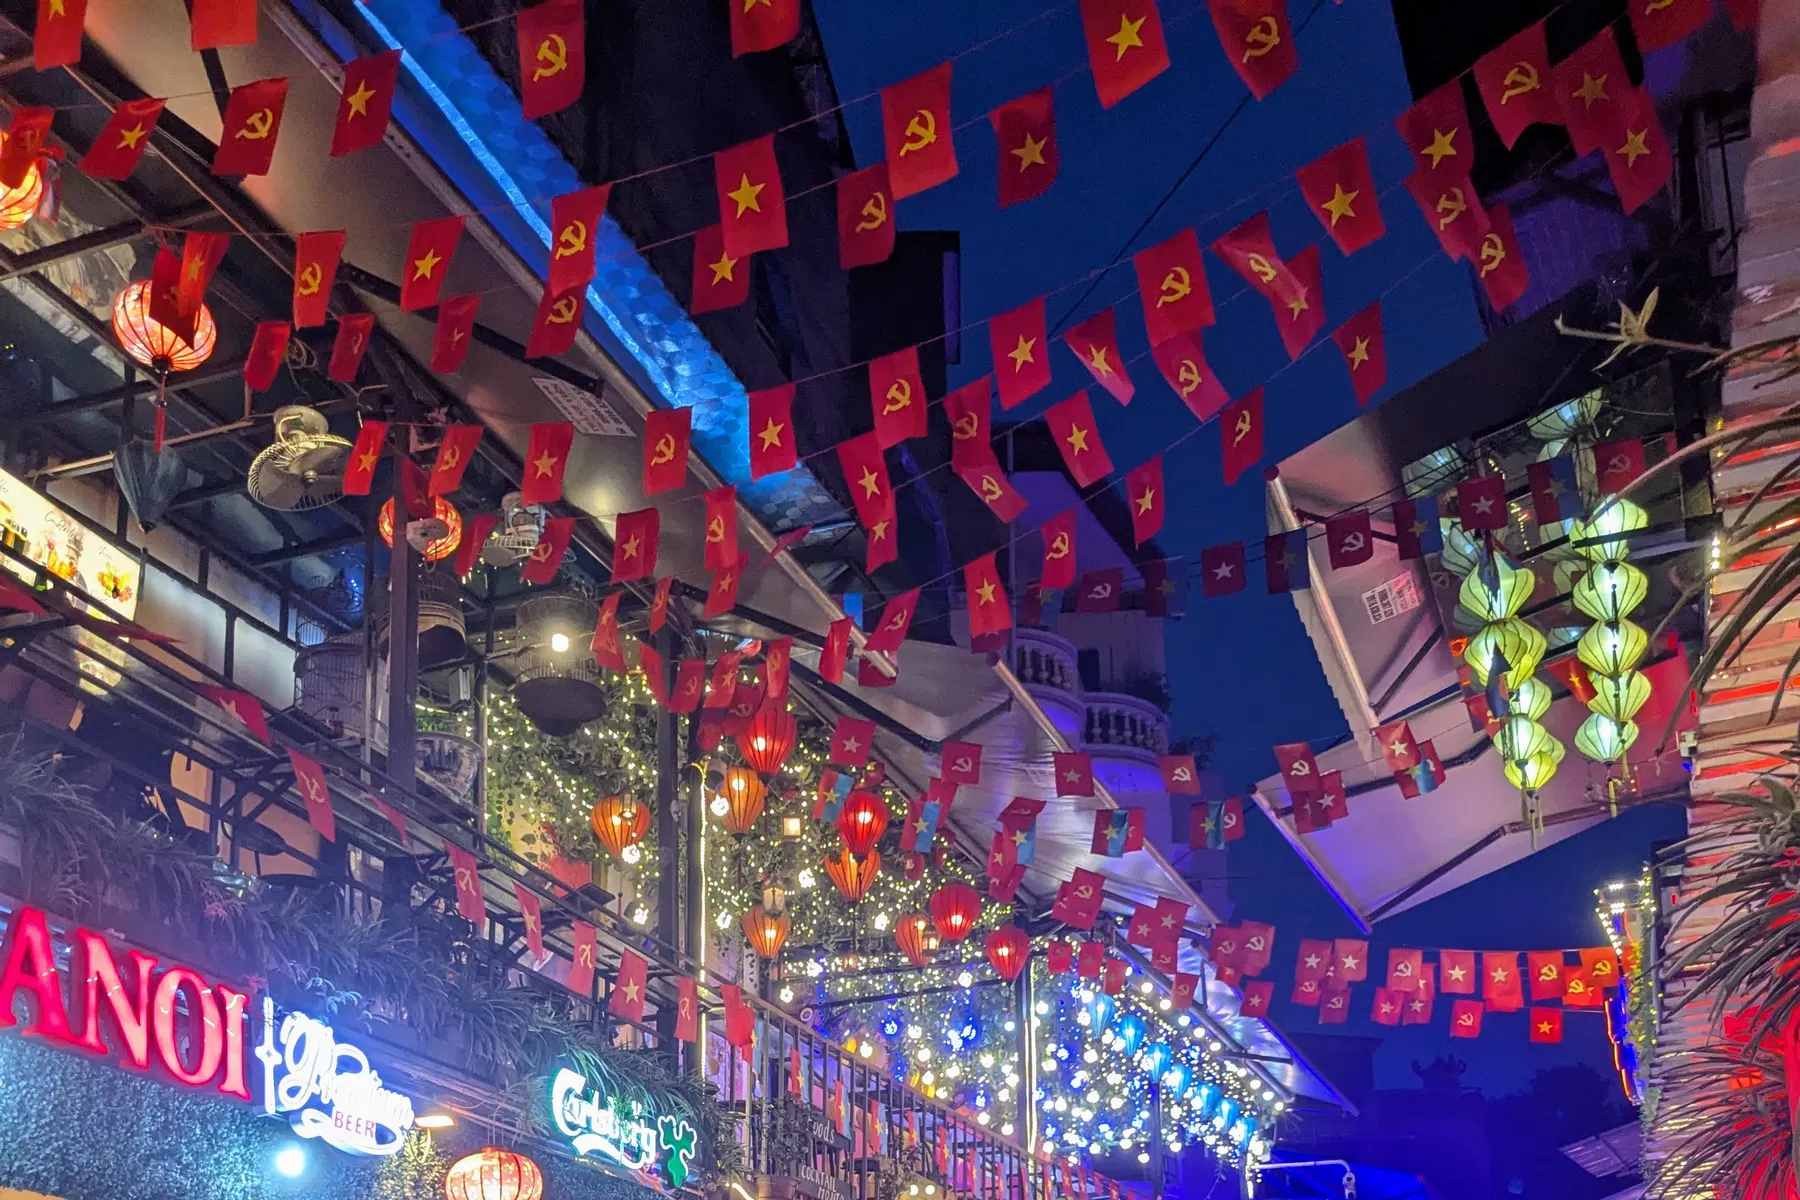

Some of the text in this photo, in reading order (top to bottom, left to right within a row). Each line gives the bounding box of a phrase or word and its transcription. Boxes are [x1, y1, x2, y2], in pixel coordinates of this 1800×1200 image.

[0, 907, 250, 1101] ANOI
[333, 1110, 376, 1138] BEER
[801, 1164, 837, 1193] COCKTAIL
